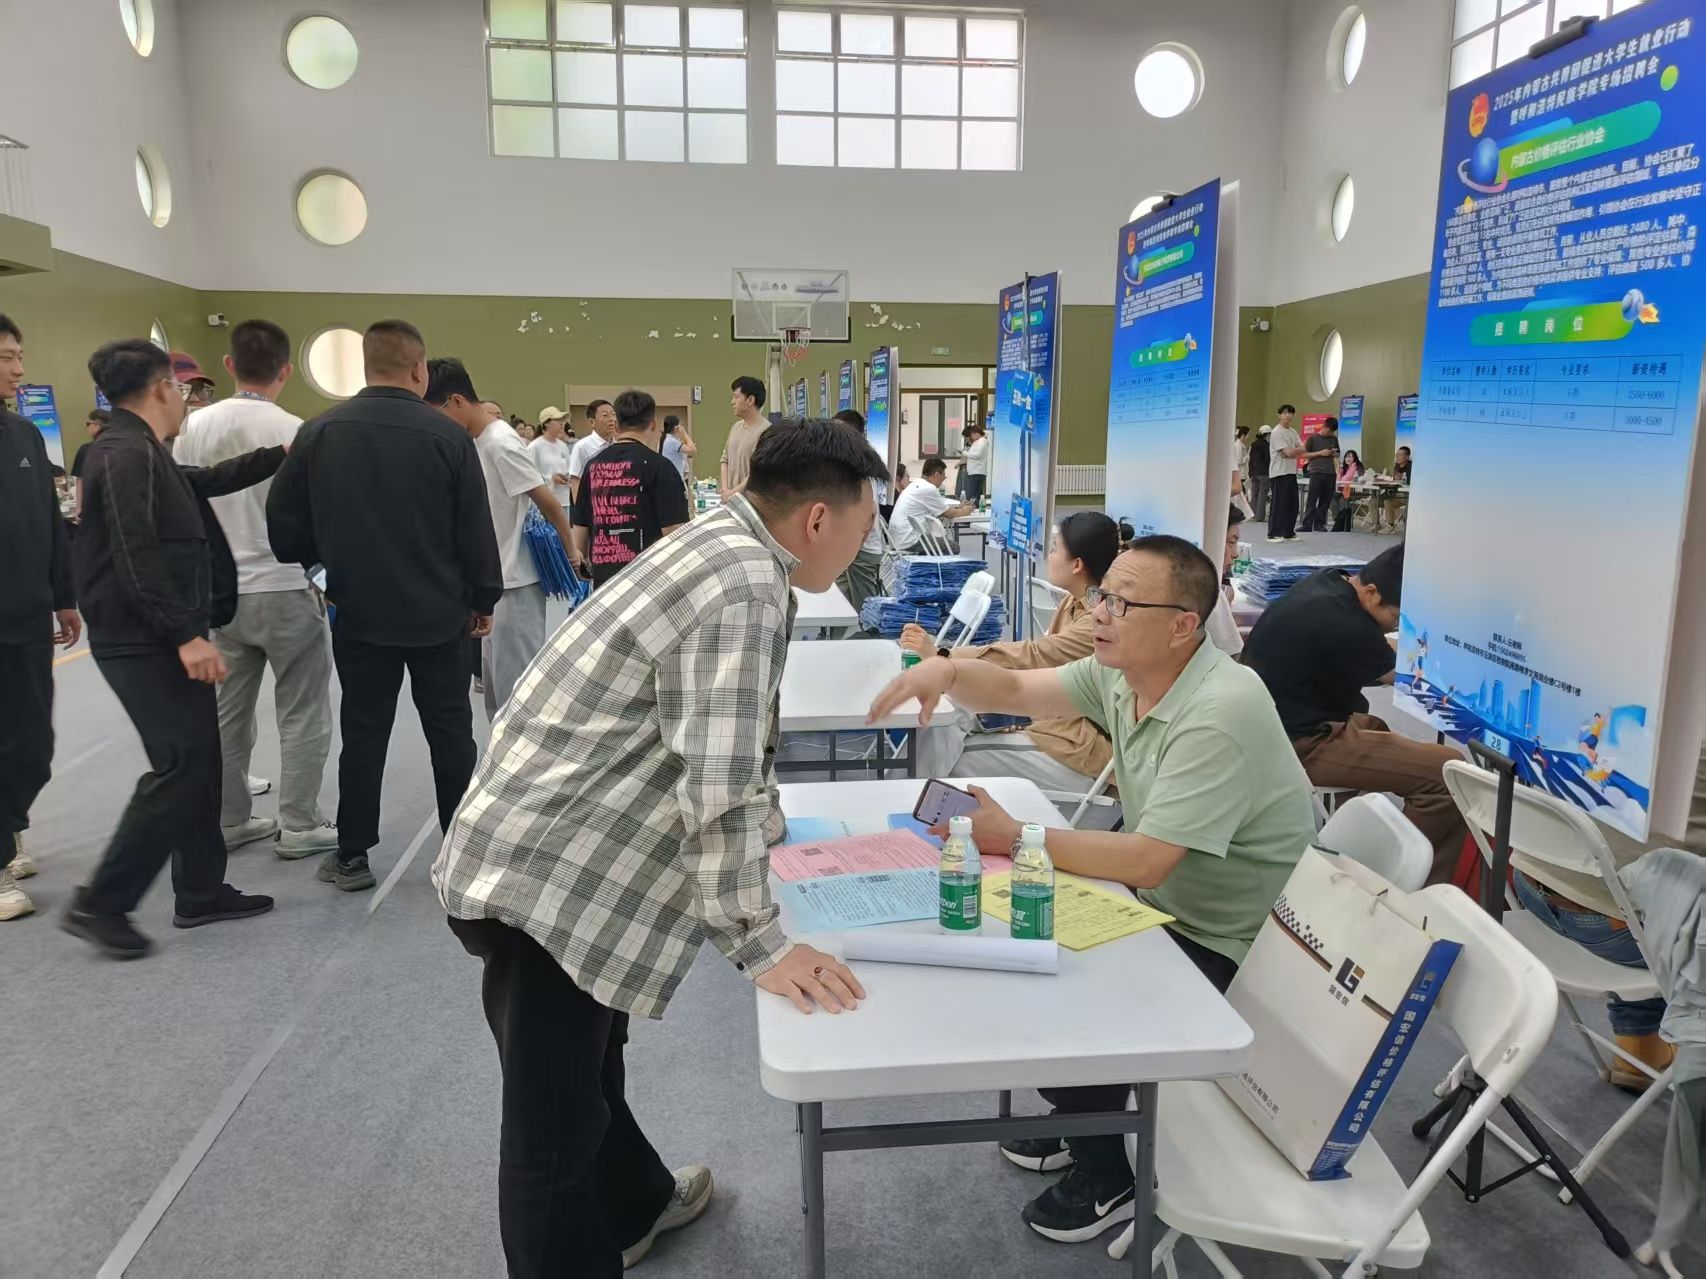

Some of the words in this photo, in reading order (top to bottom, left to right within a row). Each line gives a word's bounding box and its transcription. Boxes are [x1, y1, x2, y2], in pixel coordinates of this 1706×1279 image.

[1495, 316, 1583, 336] 招聘岗位
[1491, 735, 1501, 751] 28
[1348, 1010, 1417, 1133] 国宏信价格评估有限公司
